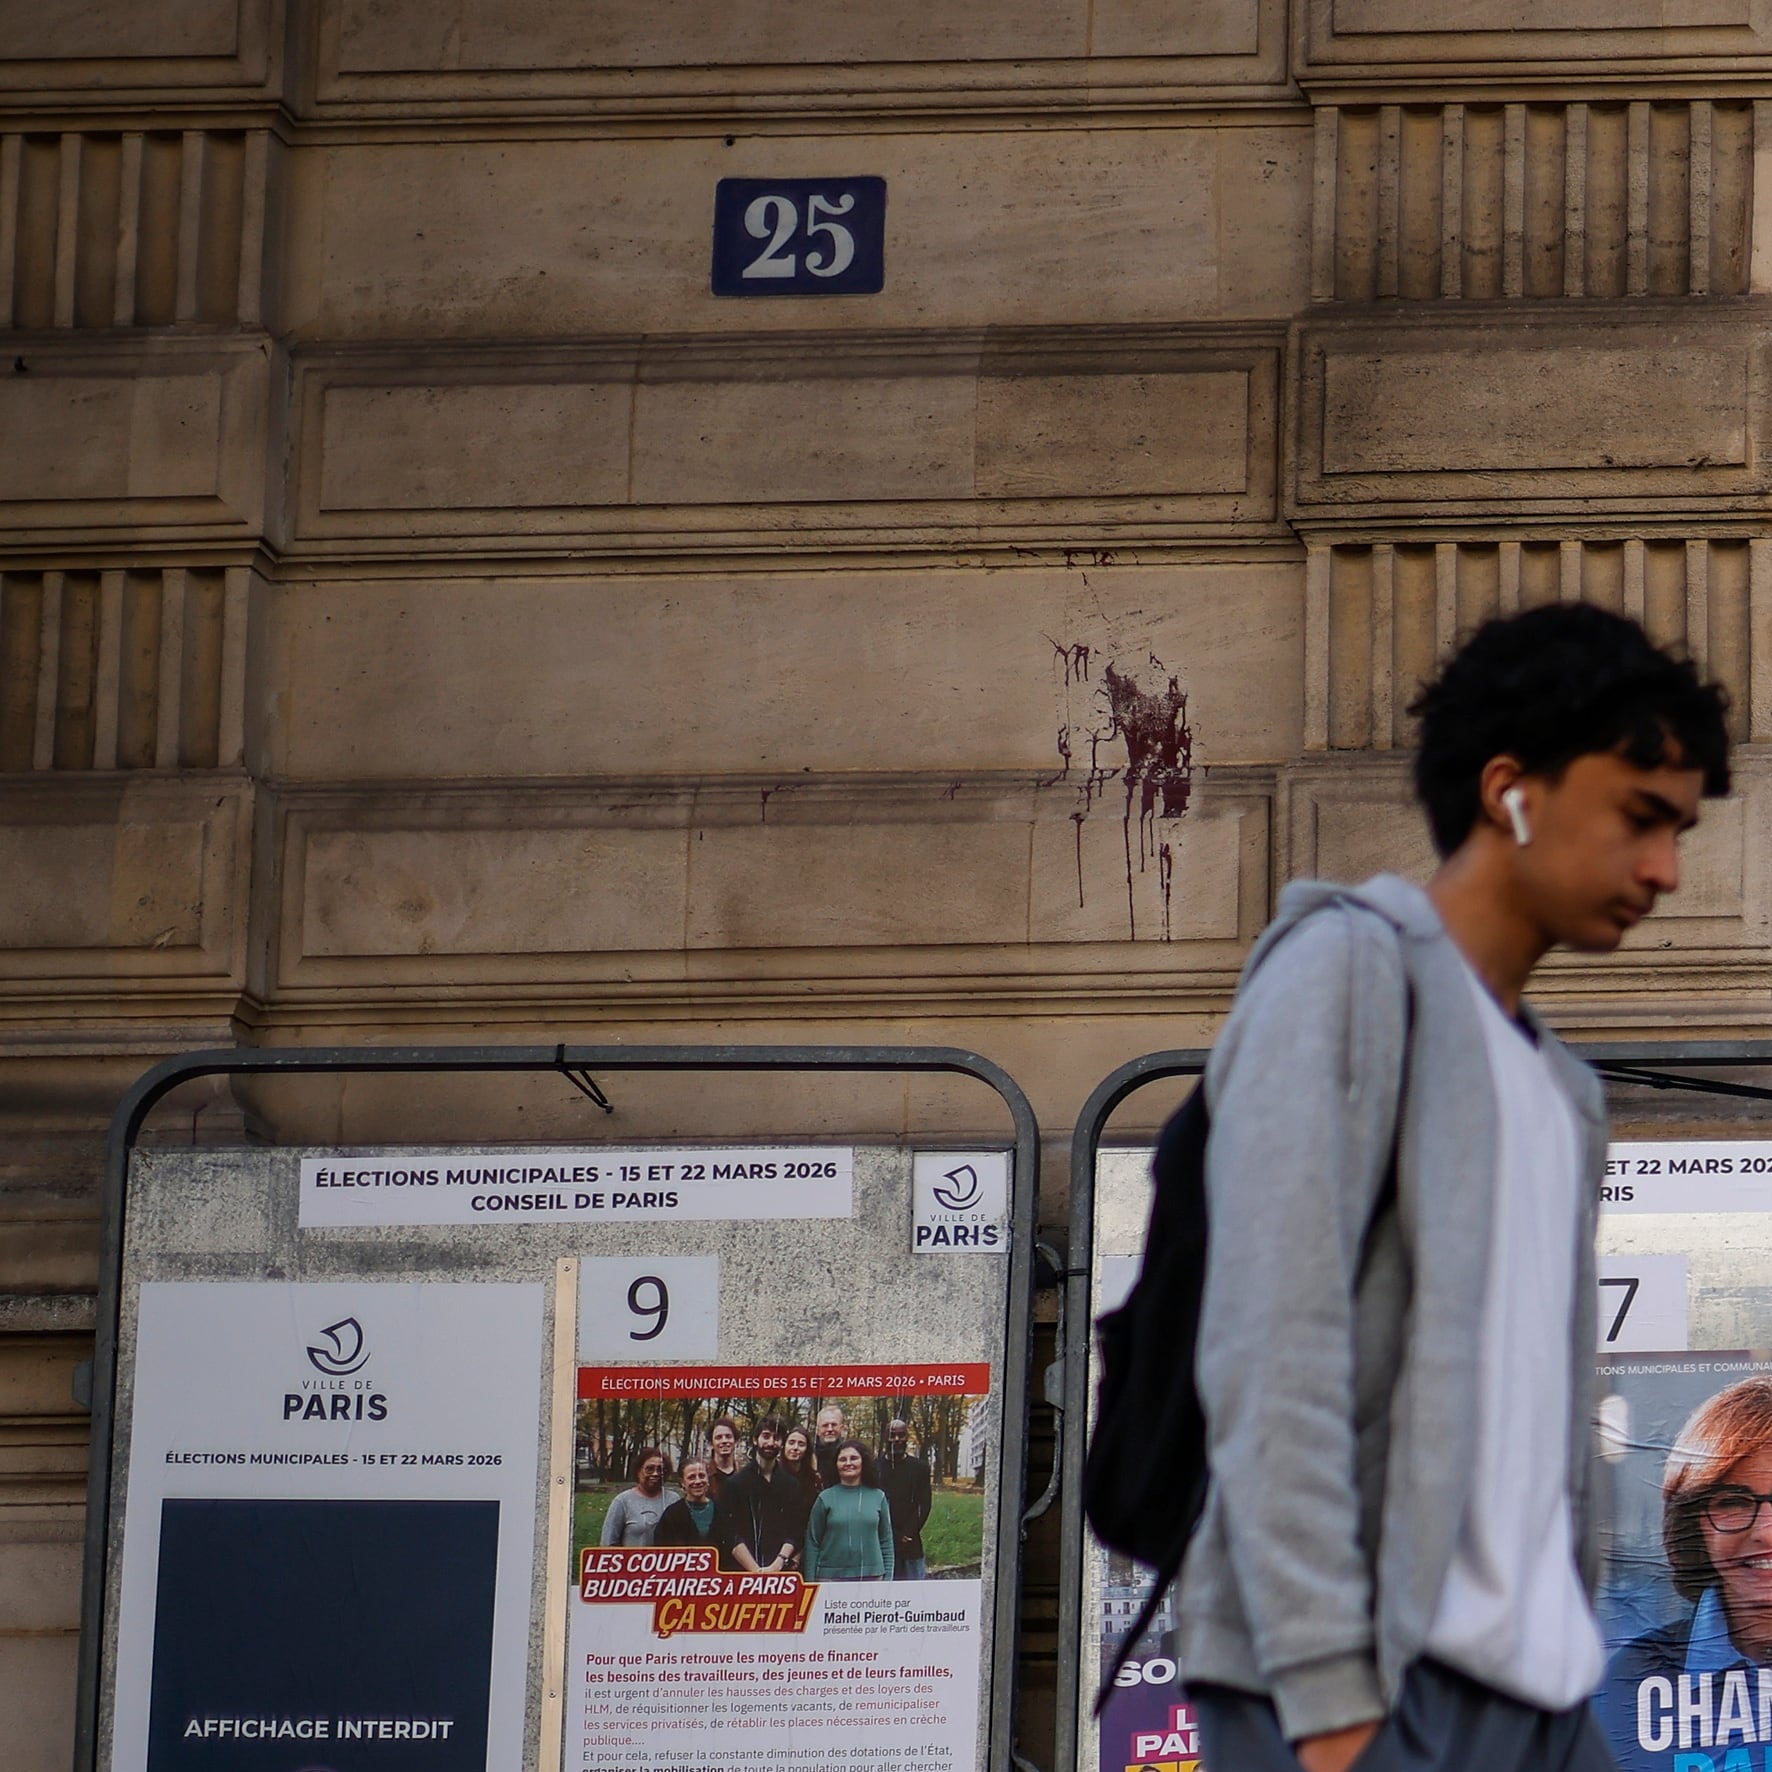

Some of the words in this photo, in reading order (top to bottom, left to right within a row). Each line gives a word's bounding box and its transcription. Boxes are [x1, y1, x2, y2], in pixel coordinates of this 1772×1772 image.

[742, 194, 855, 279] 25
[317, 1168, 438, 1187] ÉLECTIONS
[447, 1167, 598, 1184] MUNICIPALES
[620, 1166, 640, 1181] 15
[648, 1166, 674, 1180] ET
[681, 1165, 705, 1180] 22
[713, 1164, 777, 1179] MARS
[784, 1163, 836, 1178] 2026
[1606, 1161, 1630, 1174] ET
[1637, 1160, 1660, 1174] 22
[1670, 1159, 1733, 1173] MARS
[472, 1194, 567, 1210] CONSEIL
[575, 1194, 604, 1208] DE
[613, 1192, 678, 1208] PARIS
[1601, 1187, 1633, 1201] RIS
[917, 1225, 998, 1246] PARIS
[628, 1276, 668, 1340] 9
[1599, 1278, 1639, 1341] 7
[303, 1381, 344, 1389] VILLE
[355, 1381, 372, 1389] DE
[602, 1376, 670, 1389] ÉLECTIONS
[674, 1378, 759, 1389] MUNICIPALES
[764, 1378, 787, 1388] DES
[792, 1378, 806, 1388] 15
[811, 1378, 824, 1388] ET
[828, 1377, 843, 1387] 22
[847, 1377, 882, 1387] MARS
[886, 1377, 915, 1387] 2026
[928, 1375, 964, 1385] PARIS
[284, 1394, 387, 1420] PARIS
[166, 1454, 245, 1464] ÉLECTIONS
[251, 1454, 348, 1464] MUNICIPALES
[362, 1455, 375, 1464] 15
[380, 1455, 397, 1464] ET
[401, 1455, 417, 1464] 22
[422, 1455, 463, 1465] MARS
[468, 1455, 501, 1465] 2026
[585, 1554, 622, 1573] LES
[626, 1552, 711, 1573] COUPES
[583, 1575, 721, 1598] BUDGÉTAIRES
[738, 1576, 797, 1596] PARIS
[658, 1599, 695, 1637] ÇA
[700, 1603, 793, 1631] SUFFIT
[825, 1612, 860, 1623] Mahel
[865, 1610, 965, 1623] Pierot-Guimbaud
[184, 1720, 329, 1738] AFFICHAGE
[338, 1721, 453, 1738] INTERDIT
